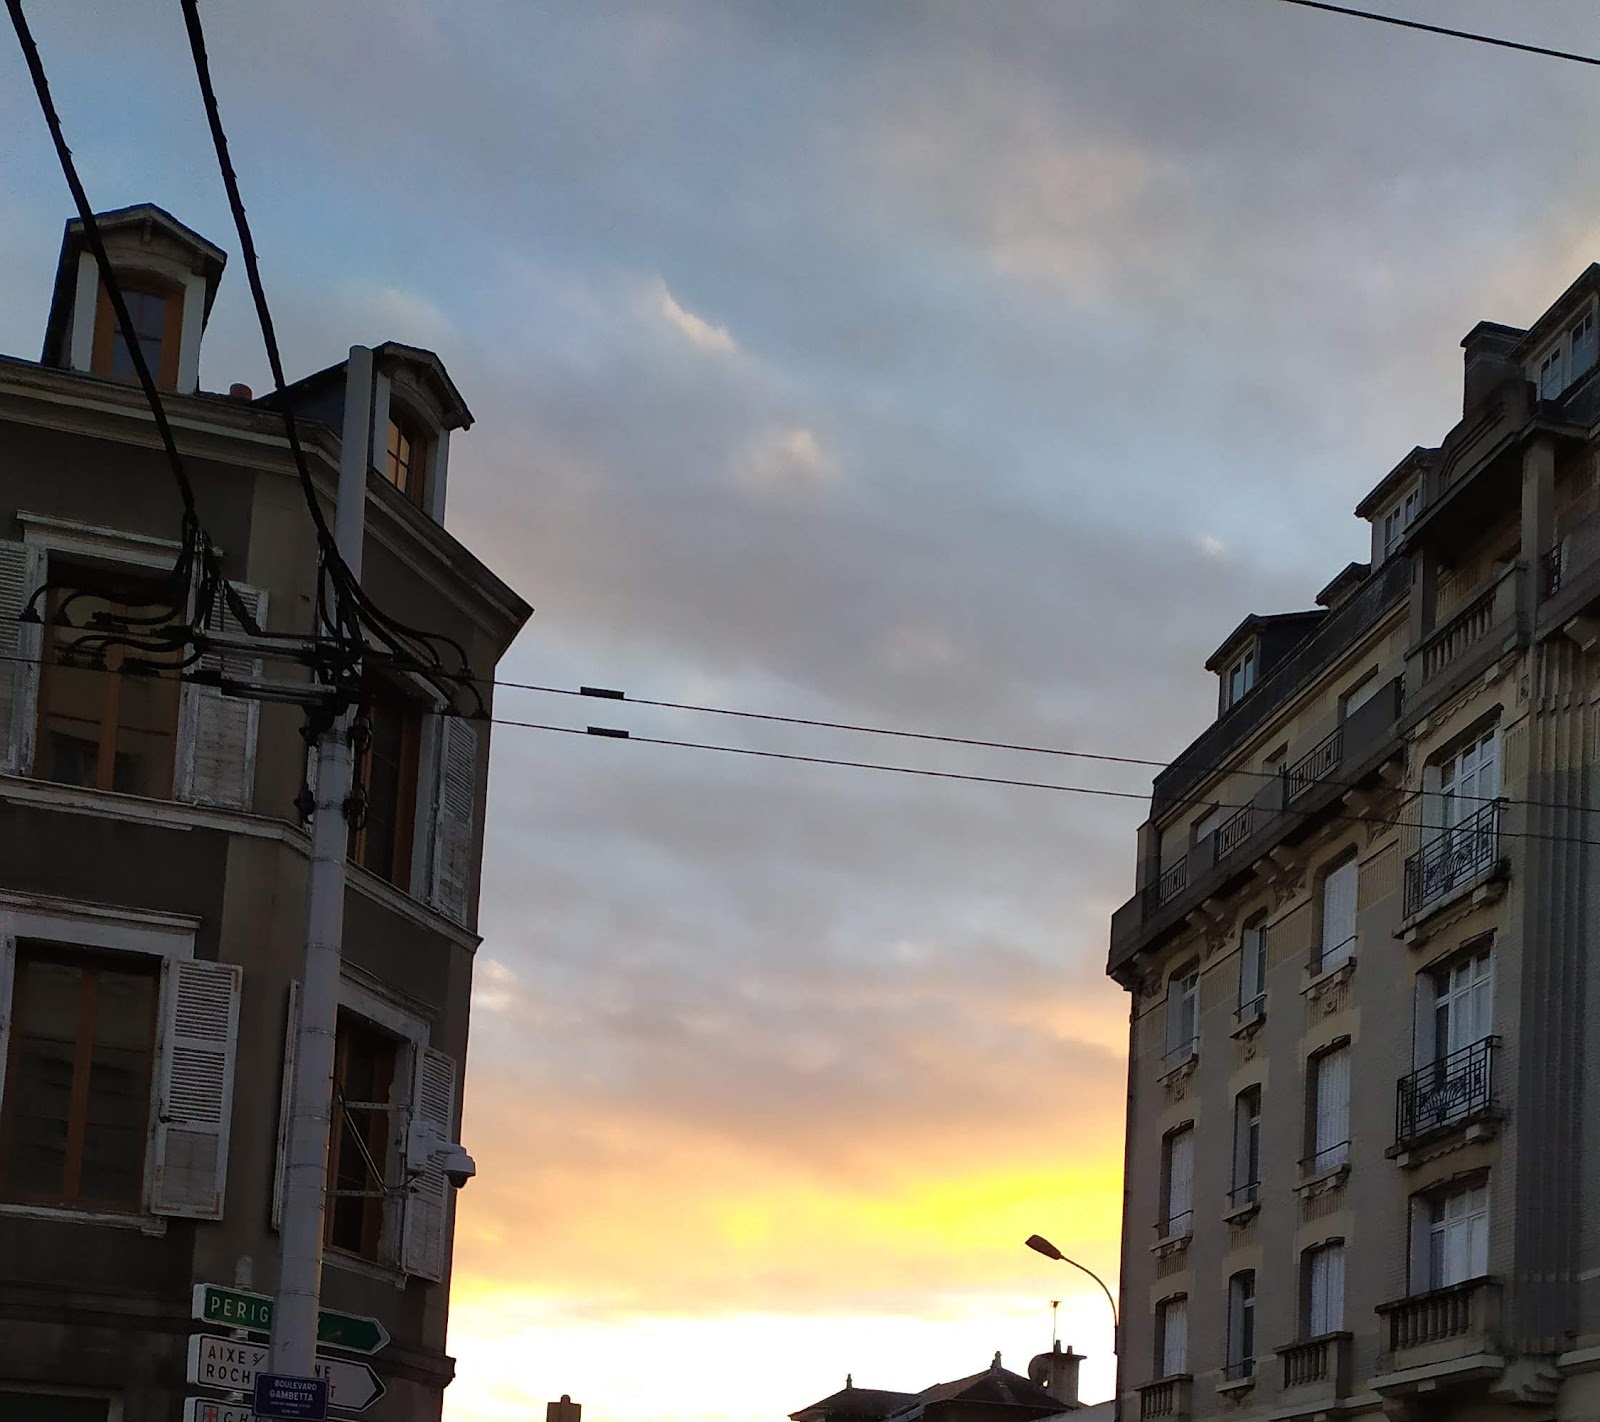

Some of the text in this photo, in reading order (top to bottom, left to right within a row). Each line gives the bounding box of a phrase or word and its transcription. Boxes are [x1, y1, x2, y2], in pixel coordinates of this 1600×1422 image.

[208, 1345, 246, 1365] AIXE
[274, 1380, 317, 1391] BOULEVARD
[269, 1389, 314, 1402] GAMBETTA
